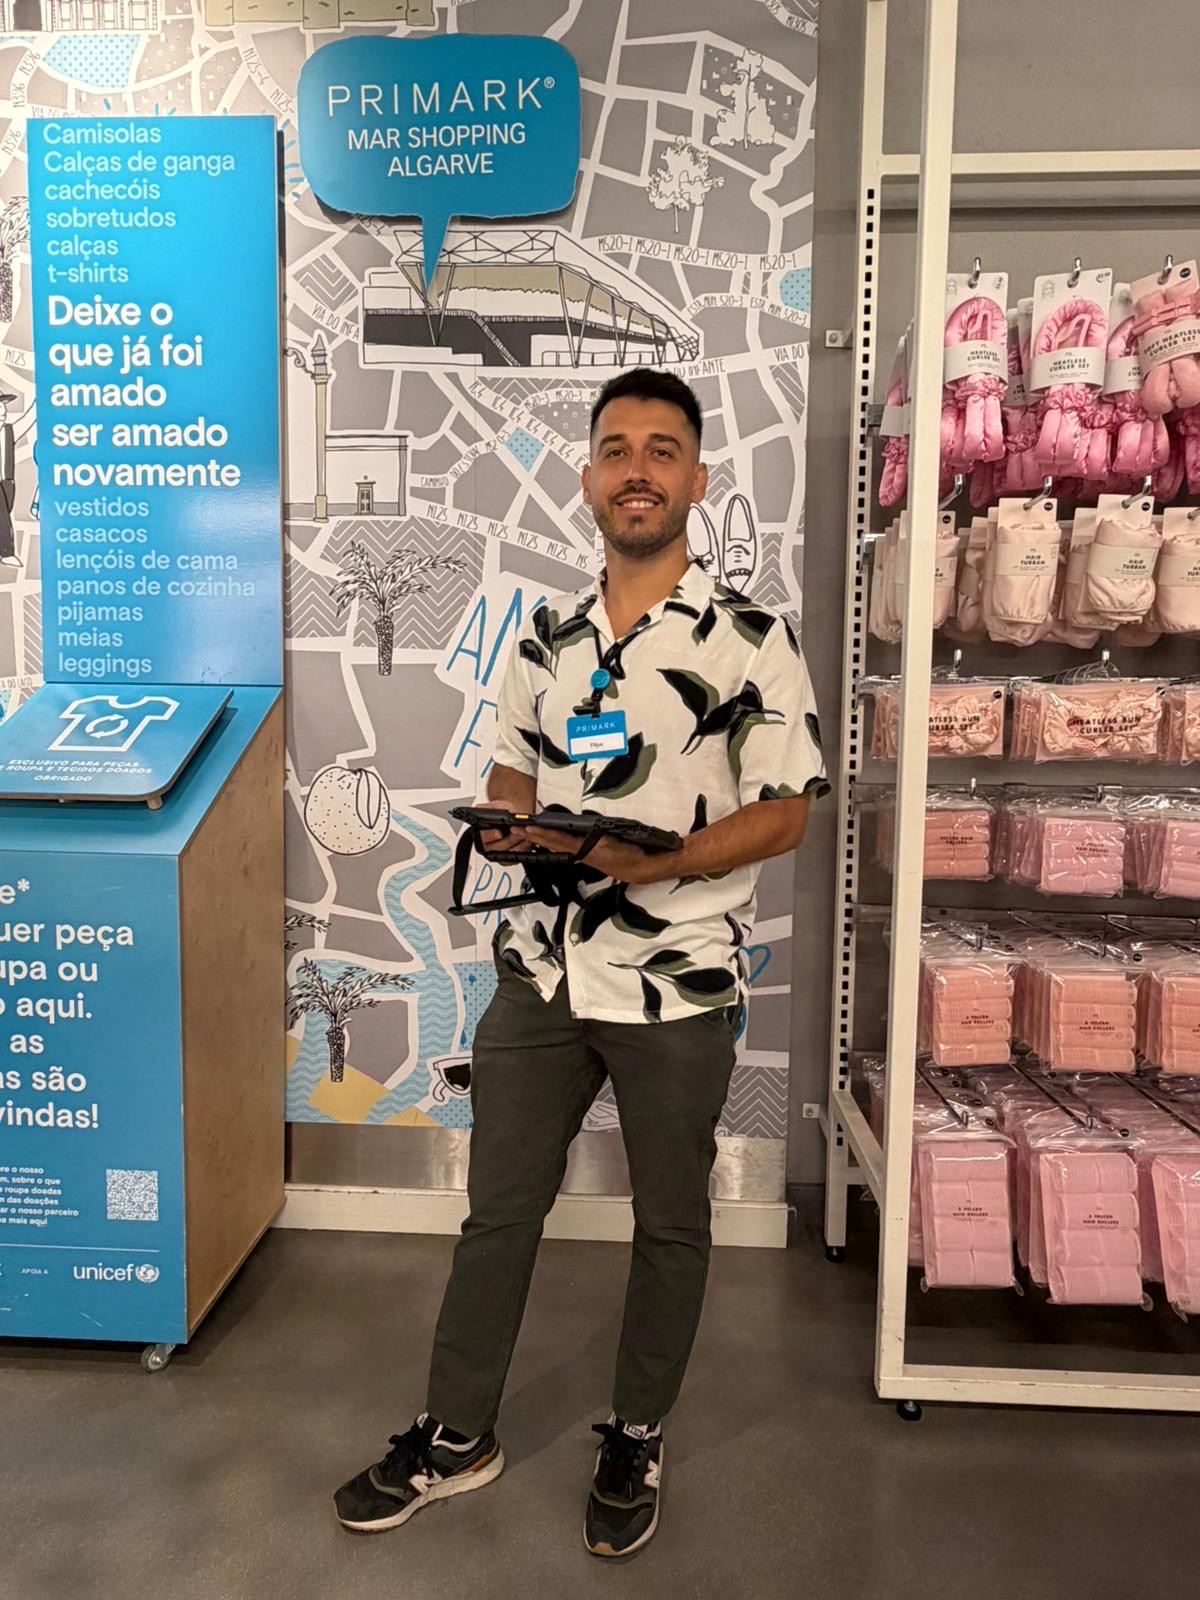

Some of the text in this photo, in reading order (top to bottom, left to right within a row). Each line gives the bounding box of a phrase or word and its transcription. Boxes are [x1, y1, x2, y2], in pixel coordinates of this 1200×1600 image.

[43, 122, 162, 145] Camisolas
[348, 123, 526, 150] MAR SHOPPING
[43, 151, 236, 176] Calças de ganga
[388, 153, 494, 177] ALGARVE
[45, 178, 161, 201] cachecóis
[46, 207, 177, 229] sobretudos
[47, 235, 119, 259] calças
[47, 262, 129, 284] t-shirts
[48, 295, 174, 326] Deixe o
[49, 334, 203, 375] que já foi
[50, 377, 167, 408] amado
[52, 416, 228, 447] ser amado
[53, 459, 241, 487] novamente
[55, 497, 150, 517] vestidos
[55, 526, 148, 544] casacos
[56, 550, 239, 574] lençóis de cama
[57, 577, 257, 600] panos de cozinha
[58, 603, 145, 627] pijamas
[58, 629, 124, 648] meias
[58, 652, 153, 678] leggings
[576, 721, 616, 733] PRIMARK
[1080, 725, 1114, 734] CURLER
[8, 759, 70, 767] EXCLUSIVO
[57, 766, 104, 774] TECIDOS
[105, 767, 153, 775] DOADOS
[33, 774, 93, 783] OBRIGADO
[56, 923, 135, 952] peça
[58, 961, 98, 983] ou
[16, 992, 92, 1025] aqui.
[10, 1033, 45, 1055] as
[32, 1065, 87, 1092] são
[11, 1176, 35, 1184] sobre
[44, 1178, 61, 1187] que
[8, 1217, 28, 1225] mais
[44, 1208, 79, 1217] parceiro
[73, 1262, 135, 1282] unicef
